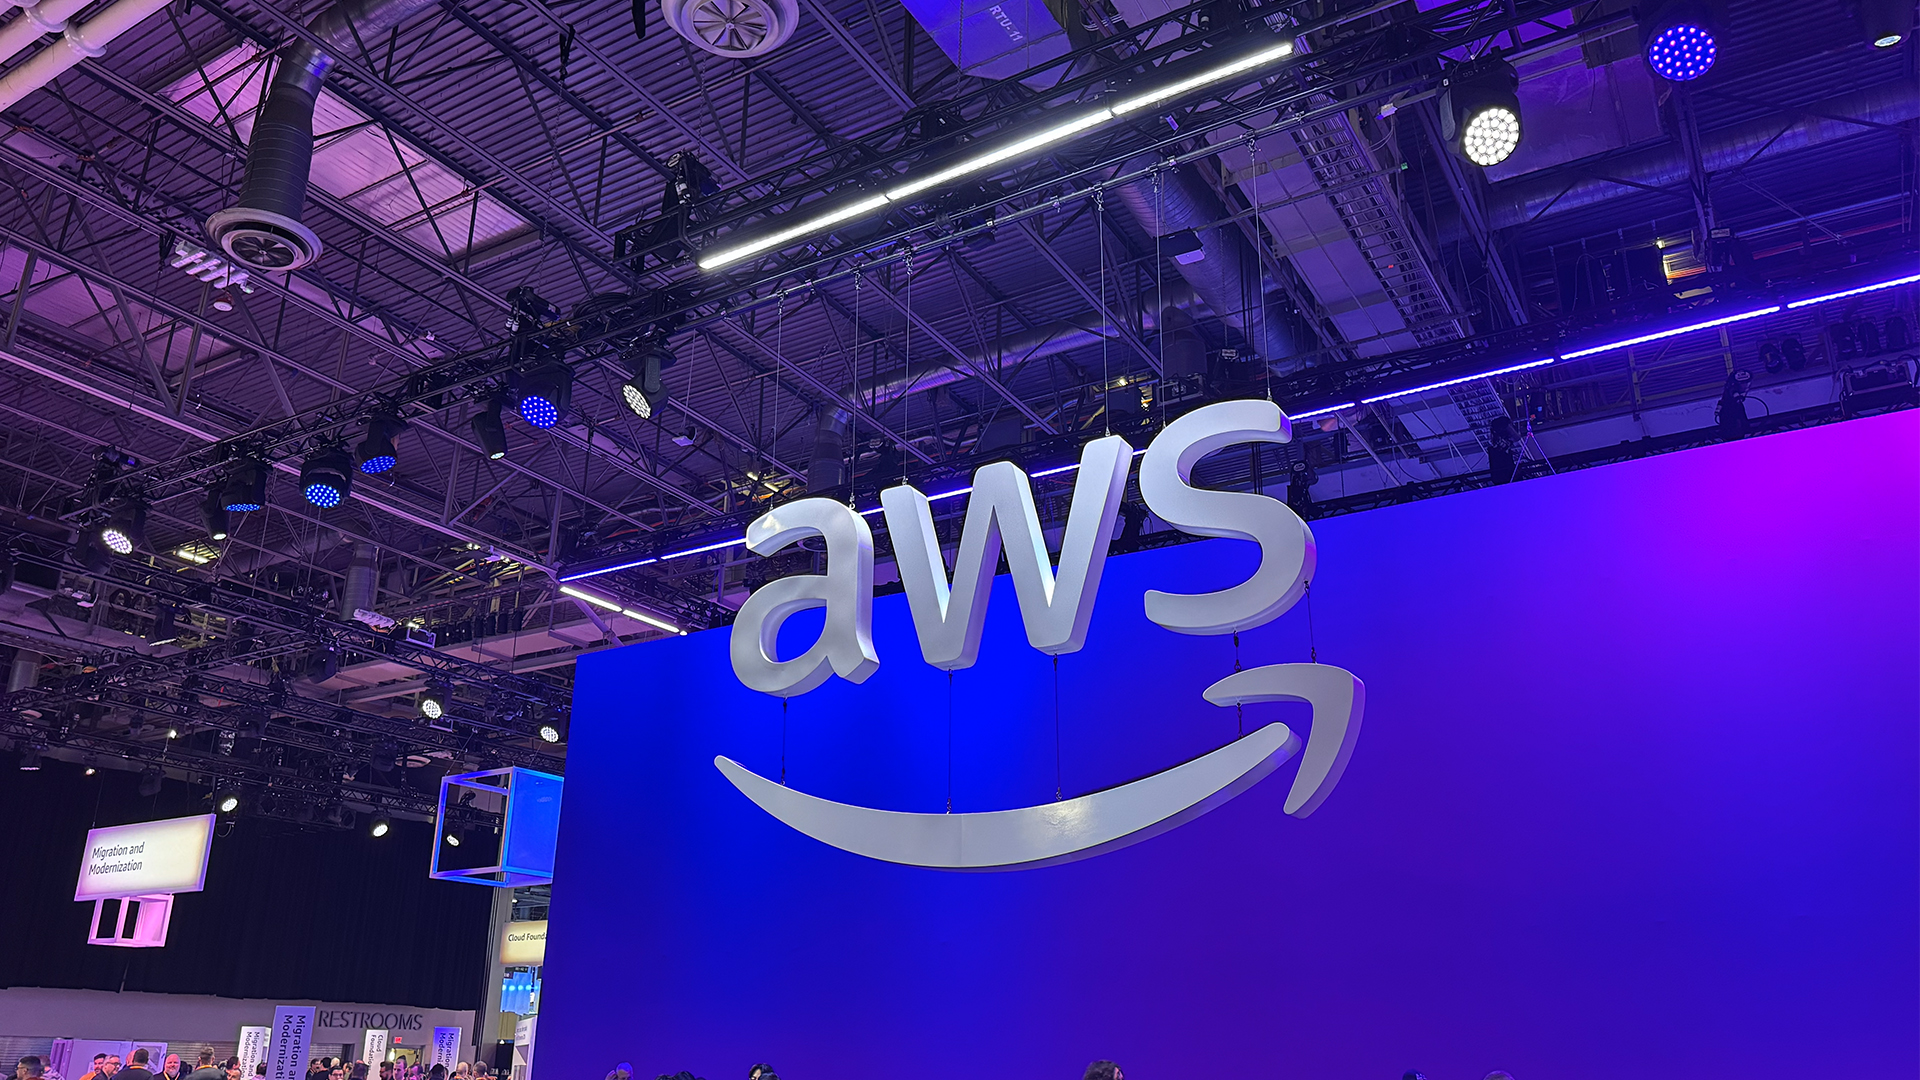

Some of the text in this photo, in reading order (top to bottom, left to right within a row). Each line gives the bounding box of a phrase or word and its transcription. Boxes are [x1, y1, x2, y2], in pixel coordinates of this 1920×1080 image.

[990, 5, 1023, 41] RTU-11
[730, 399, 1317, 698] aws
[88, 859, 143, 875] Modernization
[92, 841, 146, 861] Migration and
[508, 933, 525, 942] Cloud
[318, 1010, 423, 1031] RESTROOMS
[247, 1031, 260, 1077] Migration and
[288, 1015, 307, 1067] Migration
[367, 1034, 377, 1067] Foundatio
[376, 1034, 384, 1053] Cloud
[445, 1032, 455, 1068] Migration
